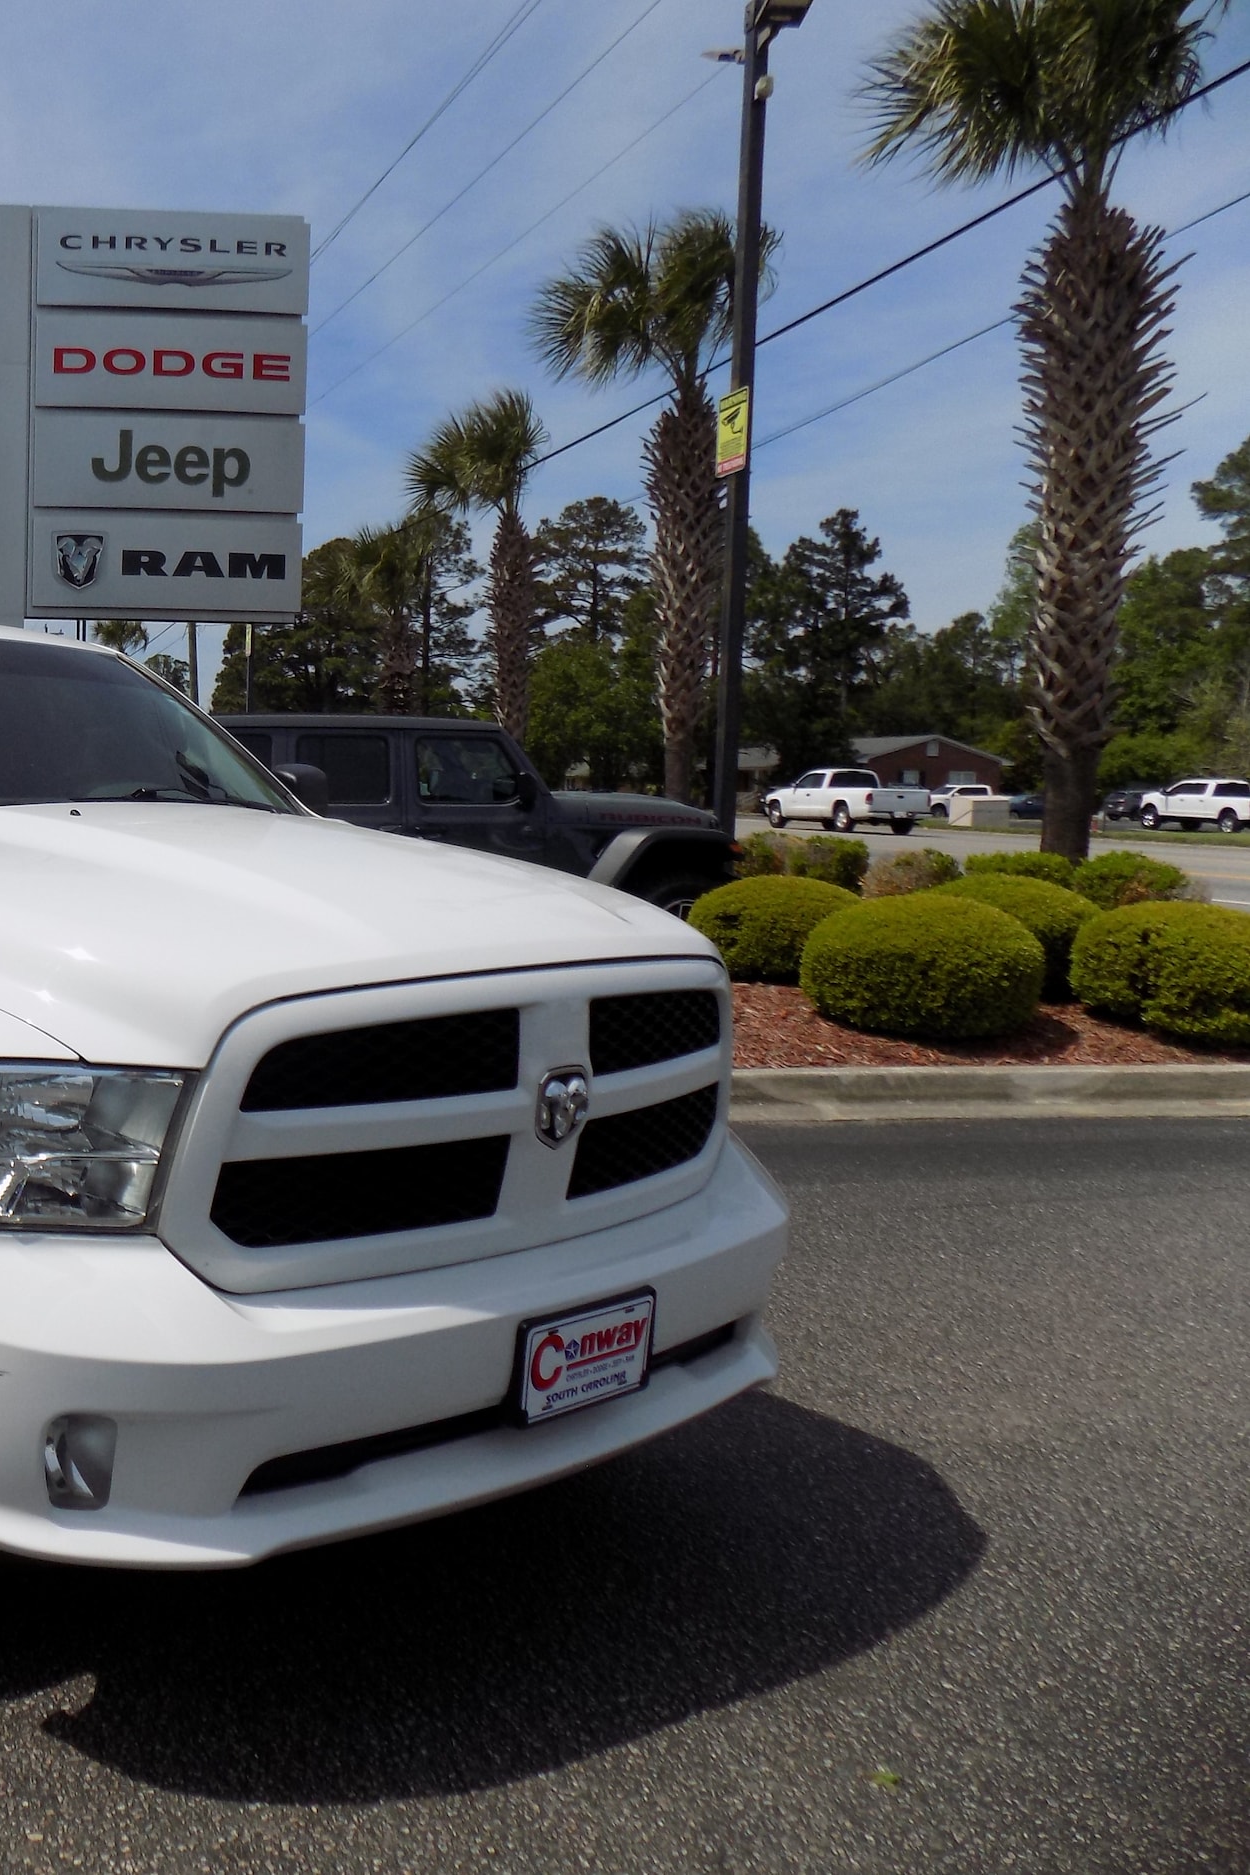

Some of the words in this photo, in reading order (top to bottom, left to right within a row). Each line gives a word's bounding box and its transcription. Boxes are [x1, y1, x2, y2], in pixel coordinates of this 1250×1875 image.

[59, 235, 287, 257] CHRYSLER
[53, 347, 291, 382] DODGE
[91, 429, 250, 498] Jeep
[121, 549, 286, 580] RAM
[598, 812, 702, 825] RUBICON
[546, 1387, 578, 1405] SOUTH
[581, 1370, 626, 1393] CAROLINA
